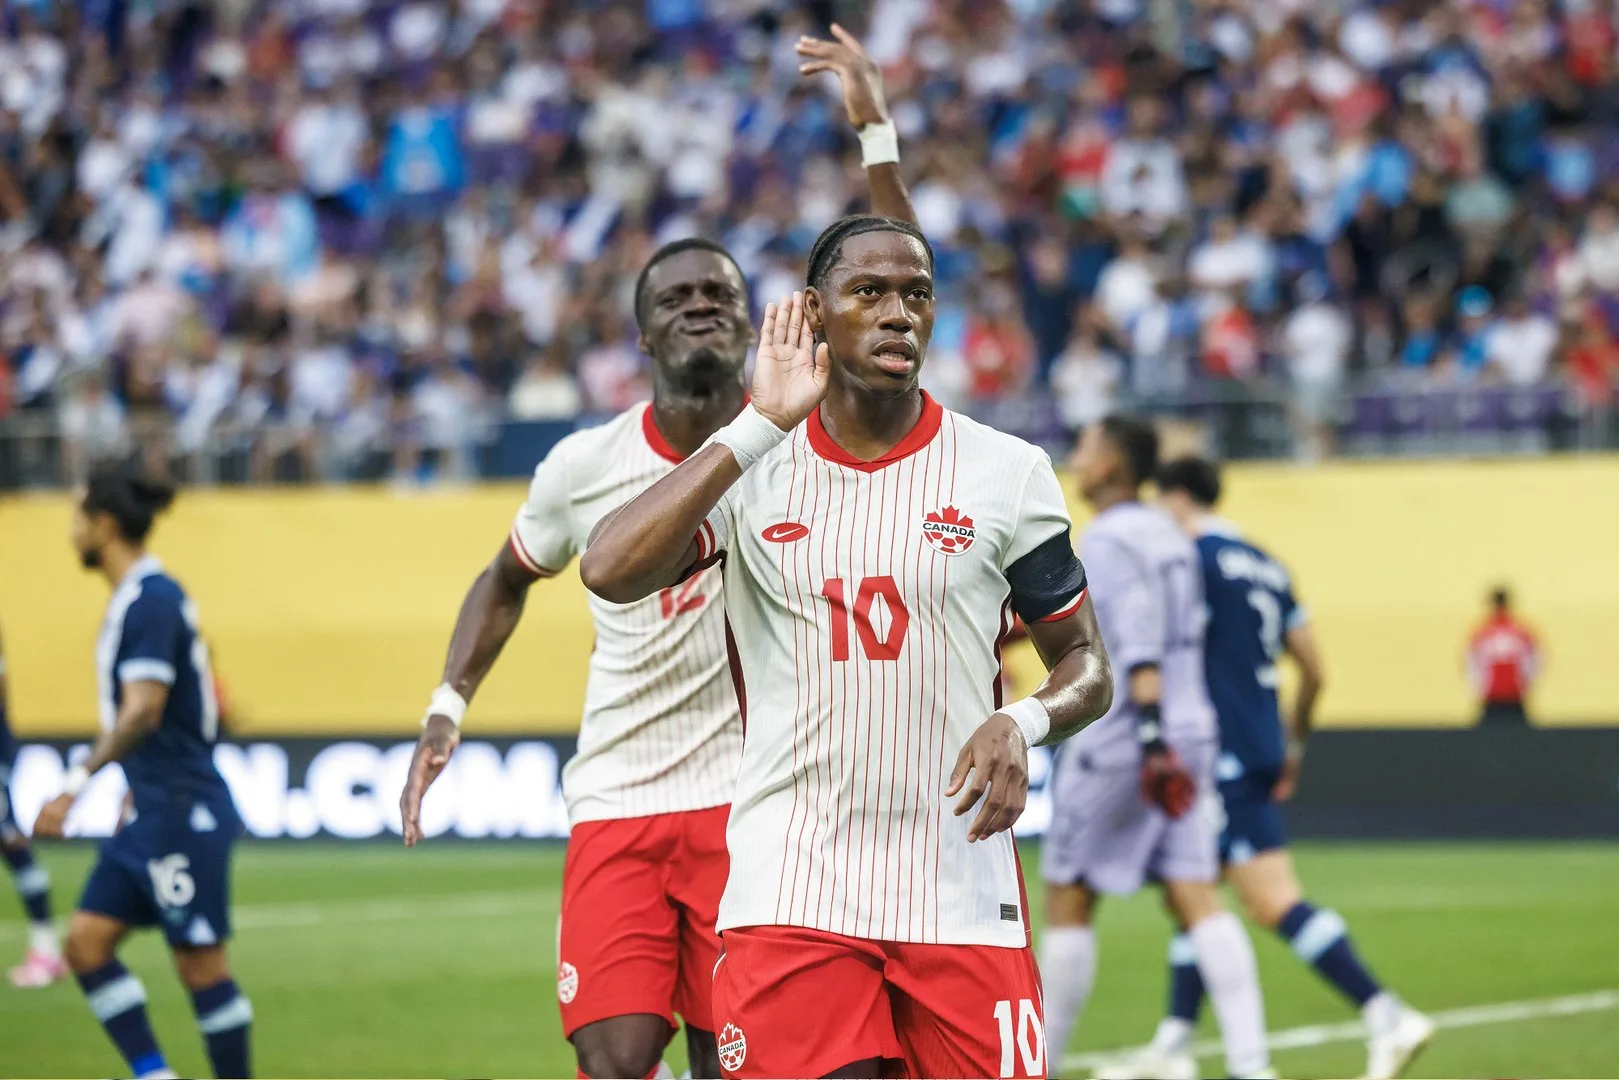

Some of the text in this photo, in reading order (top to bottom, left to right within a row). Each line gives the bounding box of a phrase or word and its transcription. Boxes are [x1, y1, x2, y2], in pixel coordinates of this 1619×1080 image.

[922, 522, 976, 539] CANADA
[821, 575, 910, 662] 10
[146, 852, 196, 910] 16
[719, 1041, 744, 1056] CANADA
[993, 998, 1044, 1078] 10
